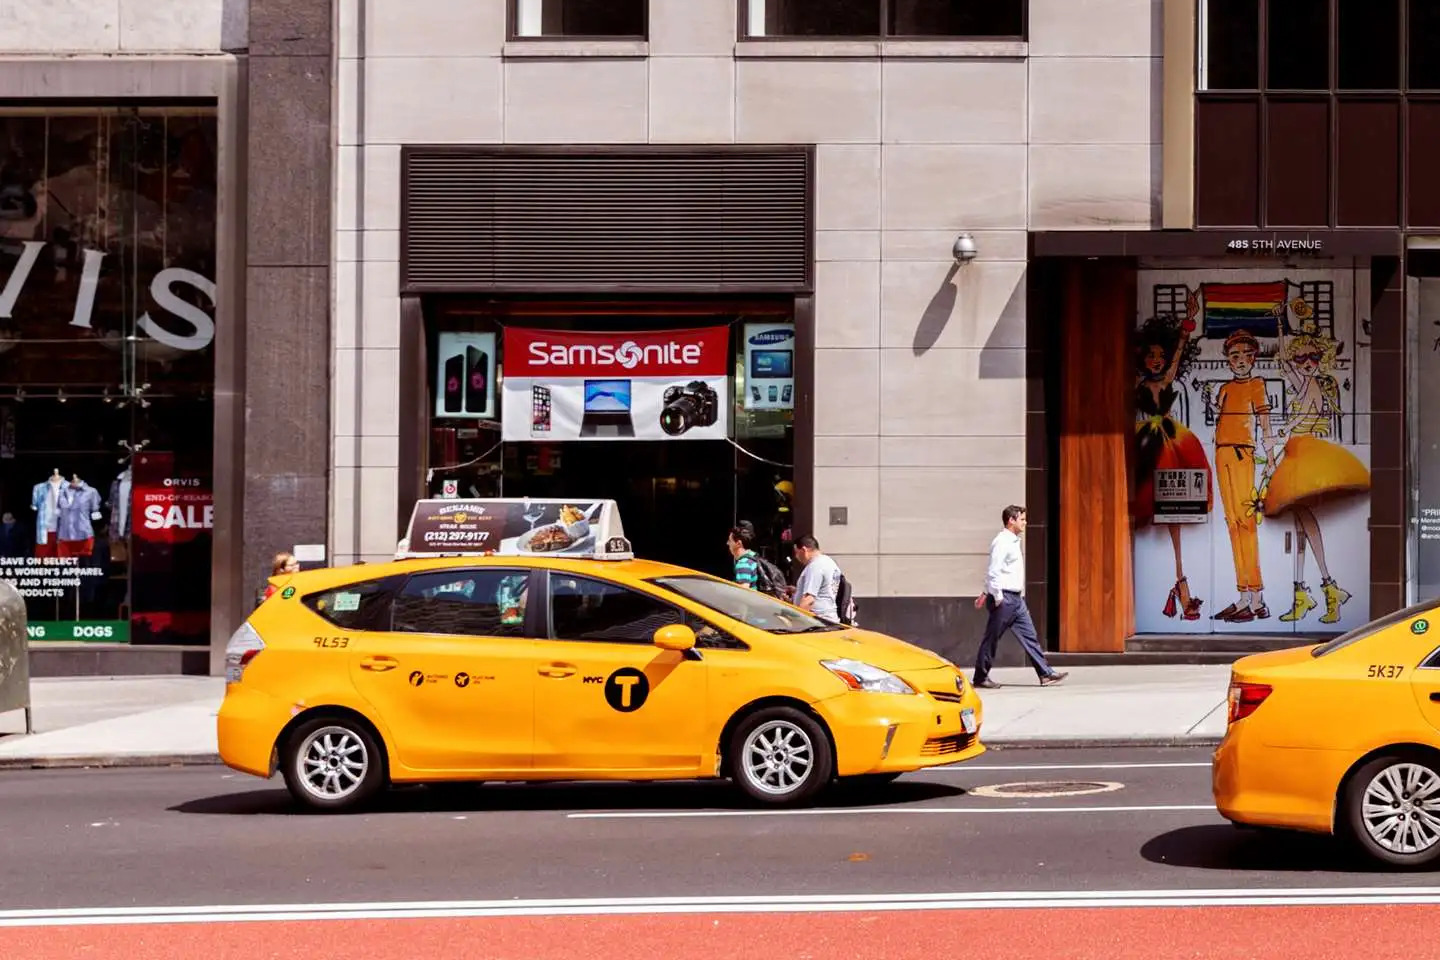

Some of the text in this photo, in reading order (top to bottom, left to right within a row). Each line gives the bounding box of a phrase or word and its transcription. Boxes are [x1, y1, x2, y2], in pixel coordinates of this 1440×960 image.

[1228, 240, 1322, 249] 485 5TH AVENUE
[163, 478, 200, 486] ORVIS
[144, 505, 213, 529] SALE
[424, 532, 490, 542] (212) 297-9177
[0, 557, 78, 565] SAVE ON SELECT
[15, 568, 60, 576] WOMEN'S
[62, 568, 104, 576] APPAREL
[18, 589, 64, 597] RODUCTS
[73, 626, 113, 637] DOGS
[583, 676, 603, 684] NYC
[614, 676, 639, 707] T
